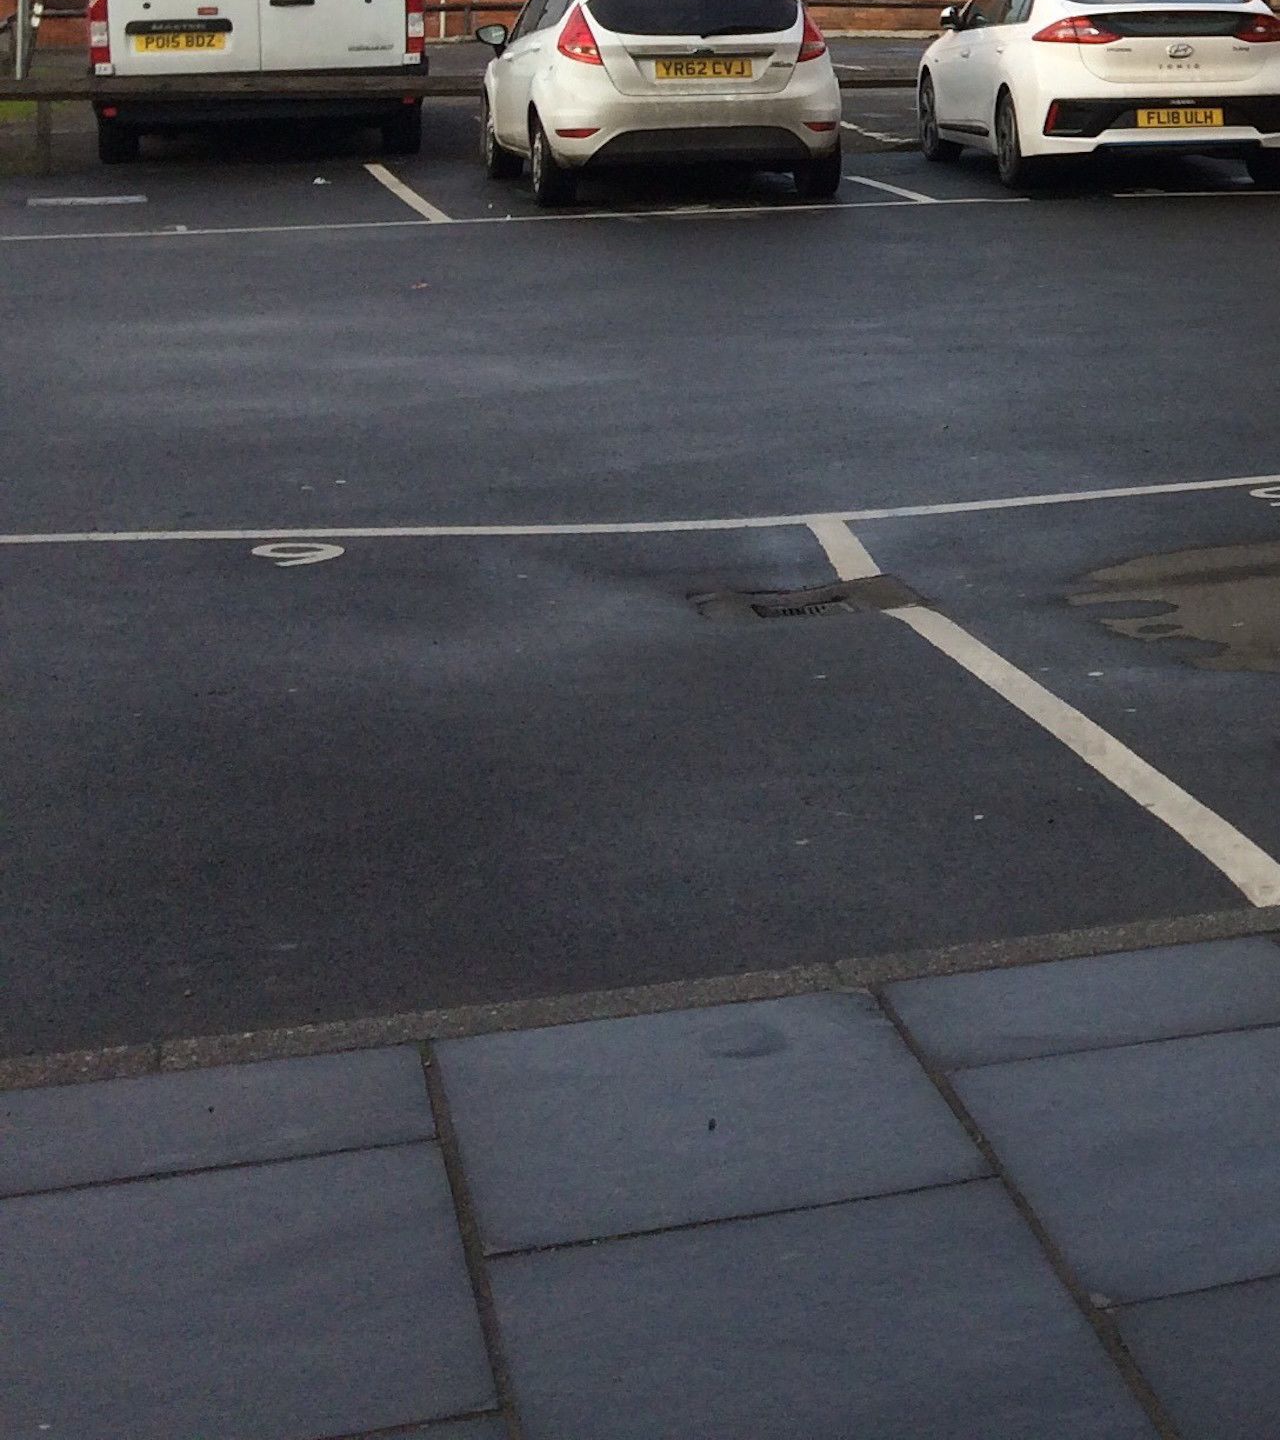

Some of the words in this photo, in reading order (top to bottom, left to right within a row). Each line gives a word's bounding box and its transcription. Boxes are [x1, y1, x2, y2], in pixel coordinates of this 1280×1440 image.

[184, 32, 216, 48] BDZ
[662, 61, 708, 76] YR62
[712, 61, 745, 76] CVJ
[1147, 111, 1180, 125] FL18
[1184, 110, 1215, 124] ULH
